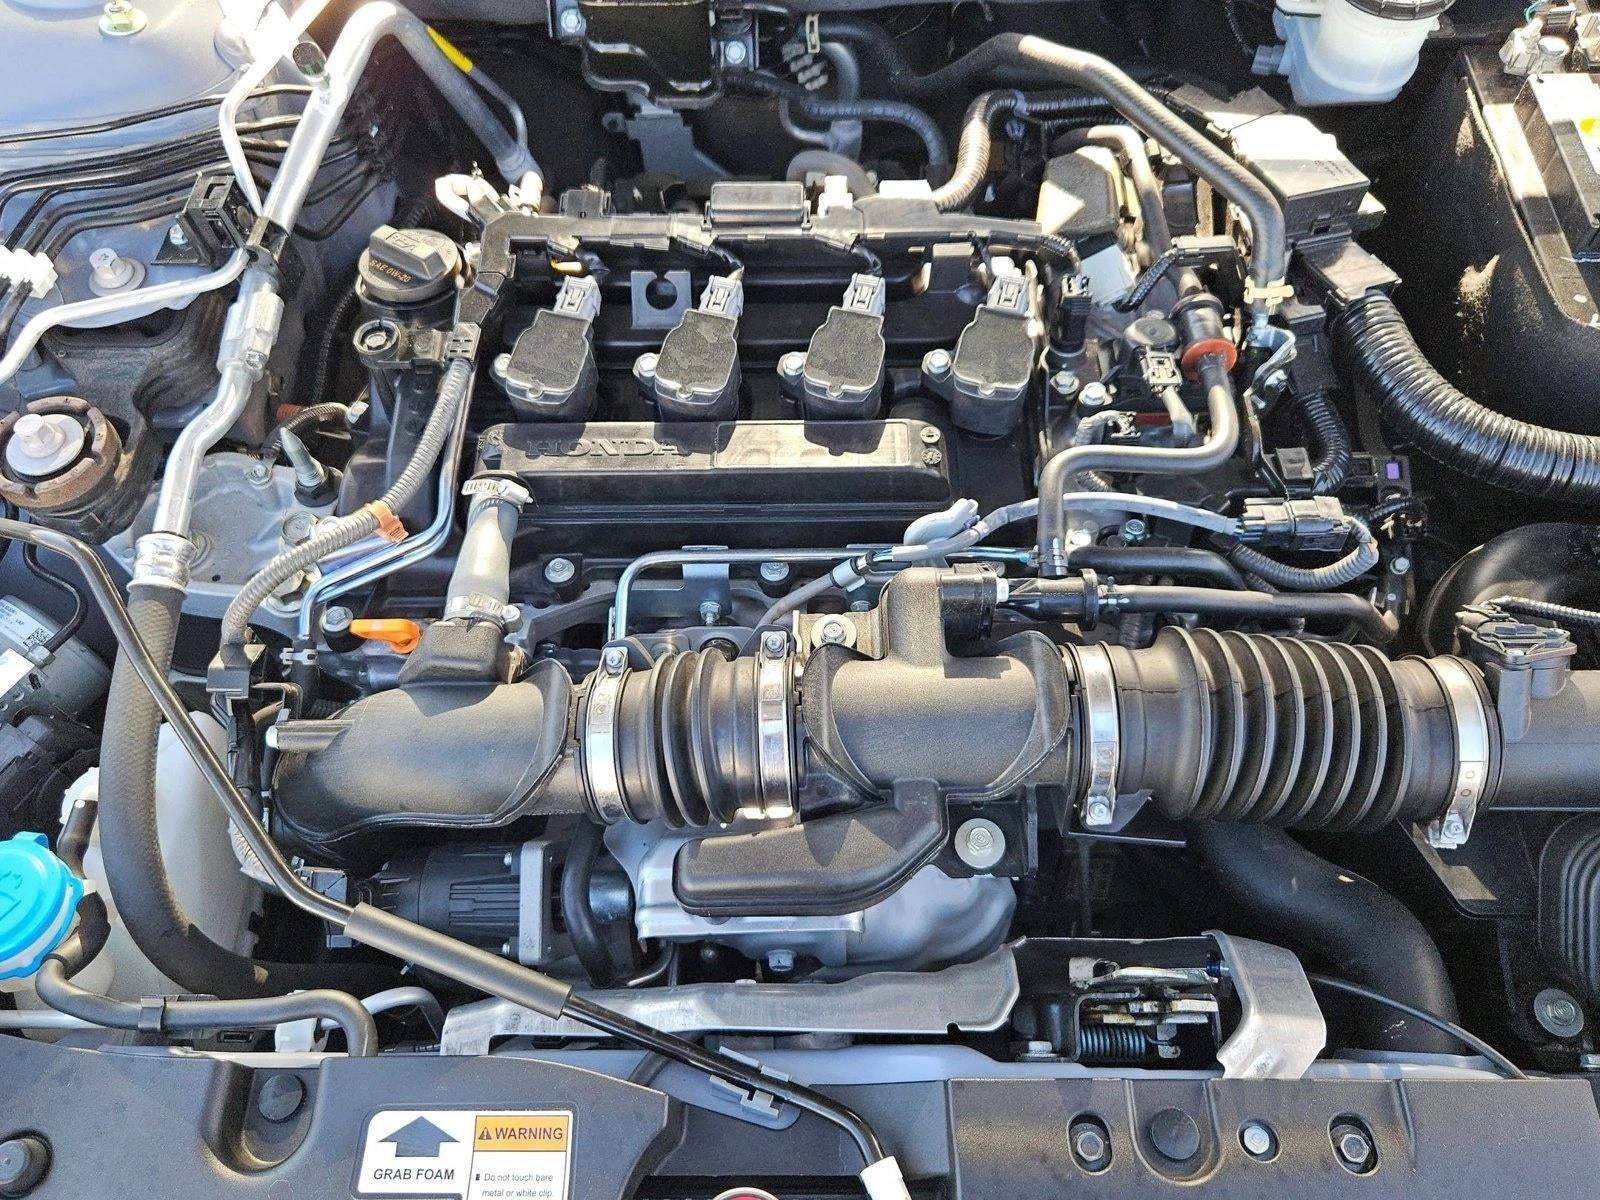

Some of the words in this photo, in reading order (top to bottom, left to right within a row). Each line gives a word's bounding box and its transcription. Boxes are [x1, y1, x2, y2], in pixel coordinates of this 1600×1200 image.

[527, 438, 684, 457] HONDA
[495, 1127, 563, 1140] WARNING
[373, 1168, 412, 1180] GRAB
[415, 1168, 455, 1180] FOAM
[484, 1173, 496, 1181] Do
[497, 1173, 510, 1181] not
[512, 1173, 533, 1181] touch
[535, 1173, 553, 1181] bare
[482, 1189, 504, 1197] metal
[516, 1189, 537, 1197] white
